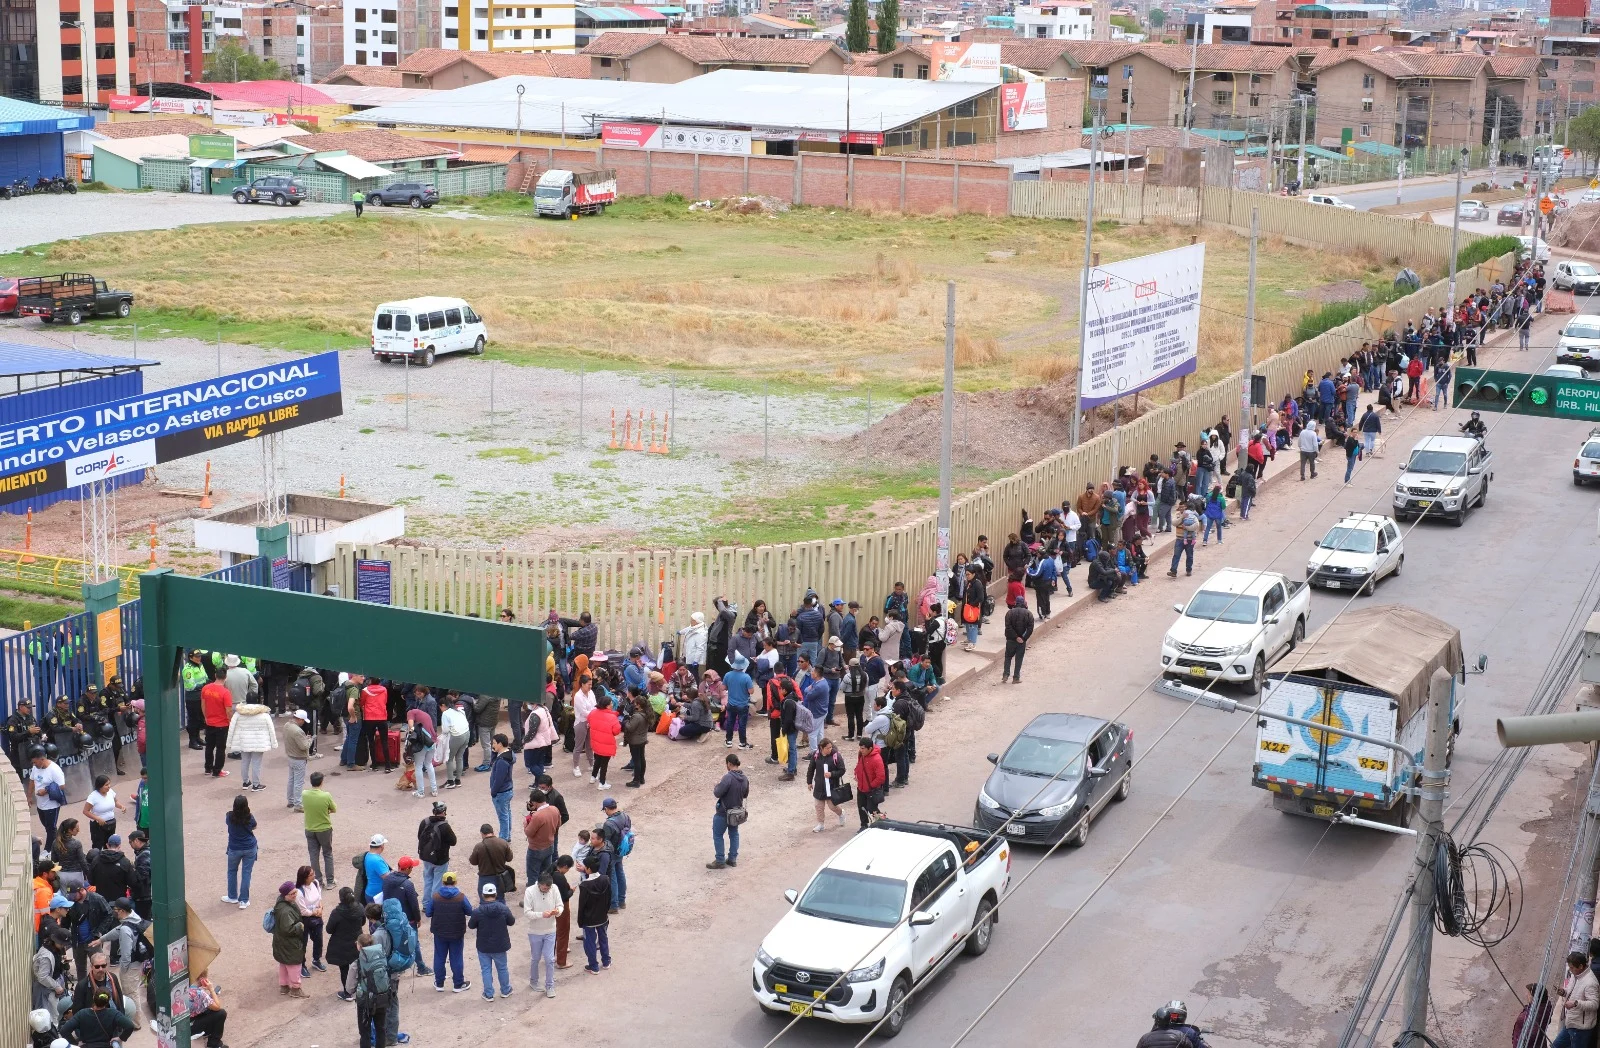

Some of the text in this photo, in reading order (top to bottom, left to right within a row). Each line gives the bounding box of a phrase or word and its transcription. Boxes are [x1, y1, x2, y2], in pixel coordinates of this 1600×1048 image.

[95, 362, 318, 426] INTERNACIONAL
[1556, 399, 1580, 410] URB.
[66, 422, 160, 453] Velasco
[164, 405, 232, 430] Astete
[244, 386, 307, 410] Cusco
[203, 404, 299, 440] VIA RAPIDA LIBRE
[75, 451, 125, 476] CORPAC
[1264, 741, 1289, 754] X2E
